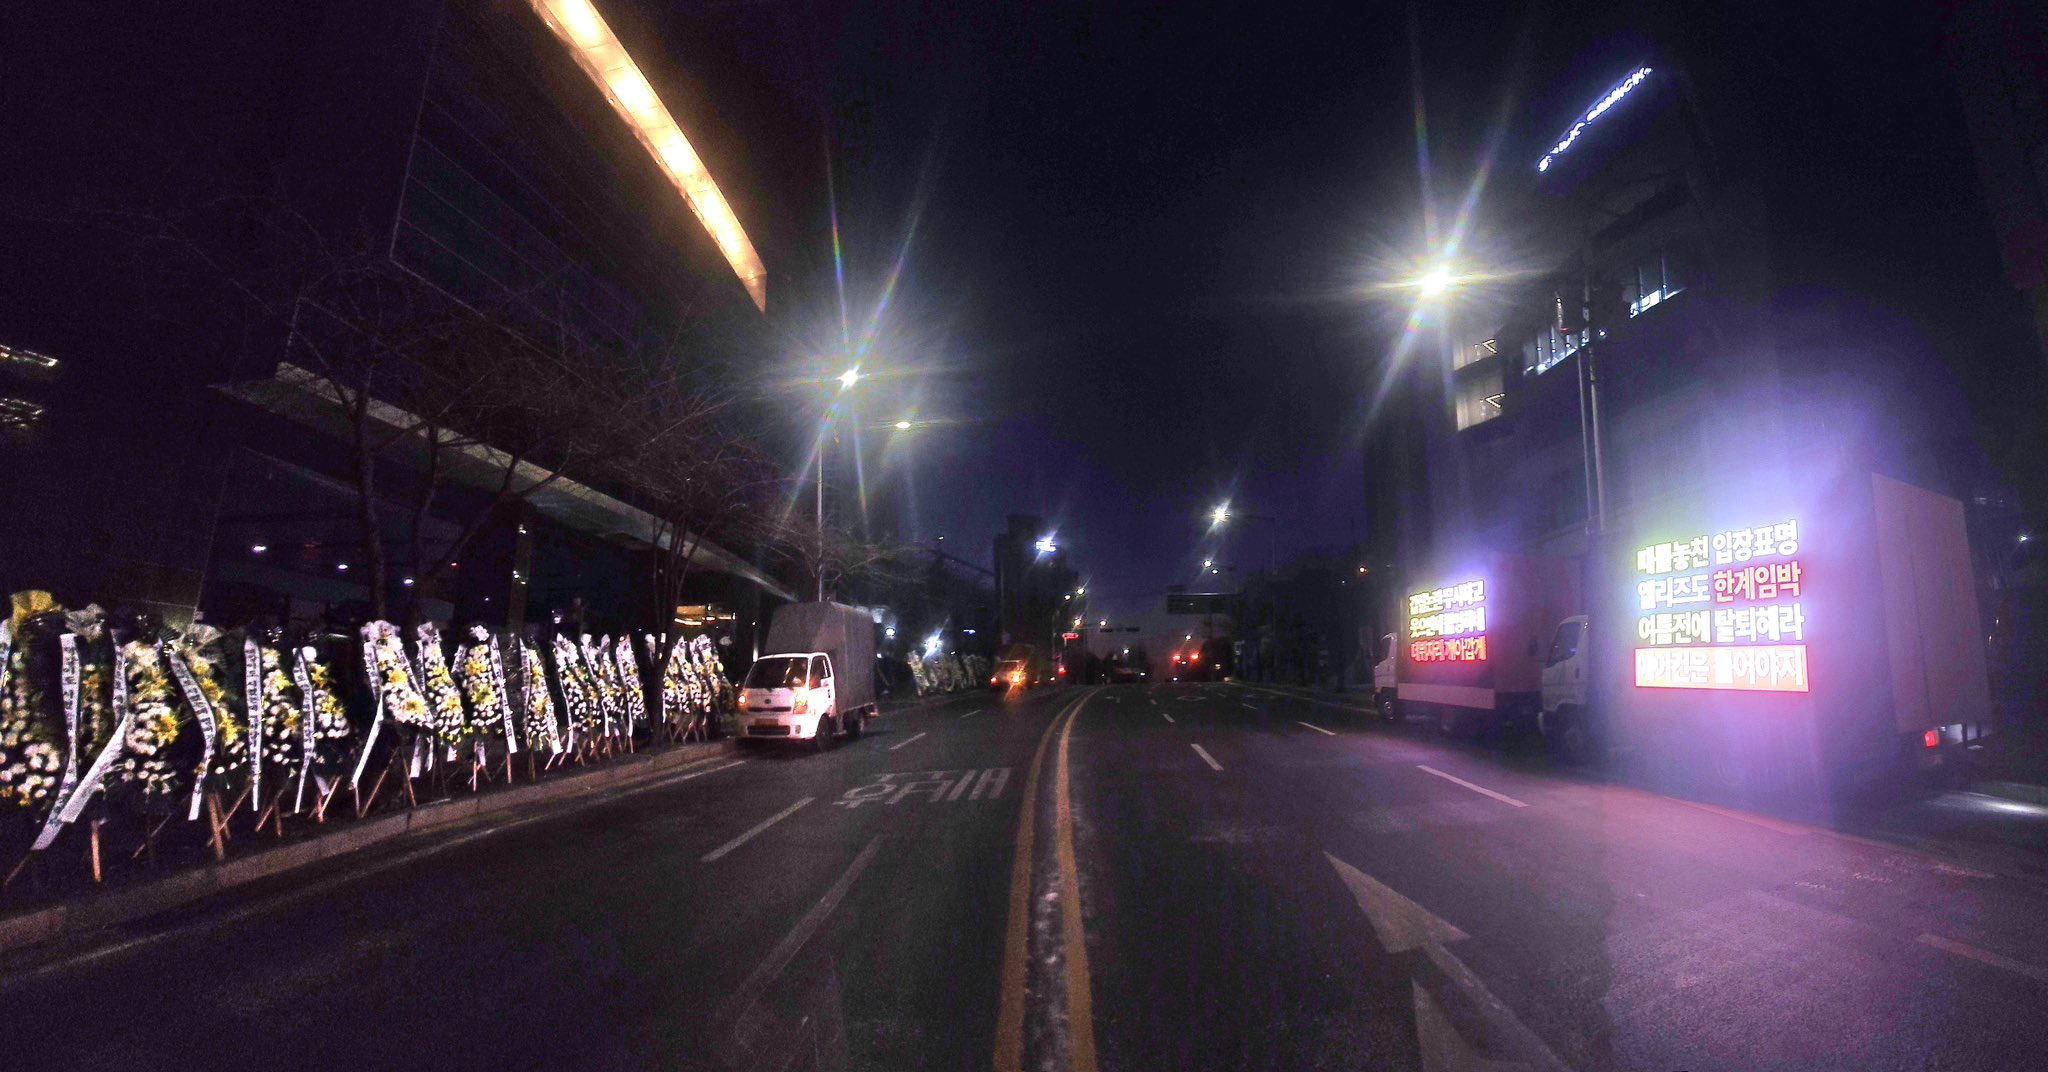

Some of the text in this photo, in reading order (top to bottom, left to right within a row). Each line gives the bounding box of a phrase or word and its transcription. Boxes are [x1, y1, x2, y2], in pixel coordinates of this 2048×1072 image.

[1636, 519, 1799, 575] 때를놓친 입장표명
[1713, 560, 1802, 603] 한계임박
[1638, 603, 1805, 646] 여름전에 탈퇴해라
[1637, 647, 1803, 685] 에어컨은 틀어야지
